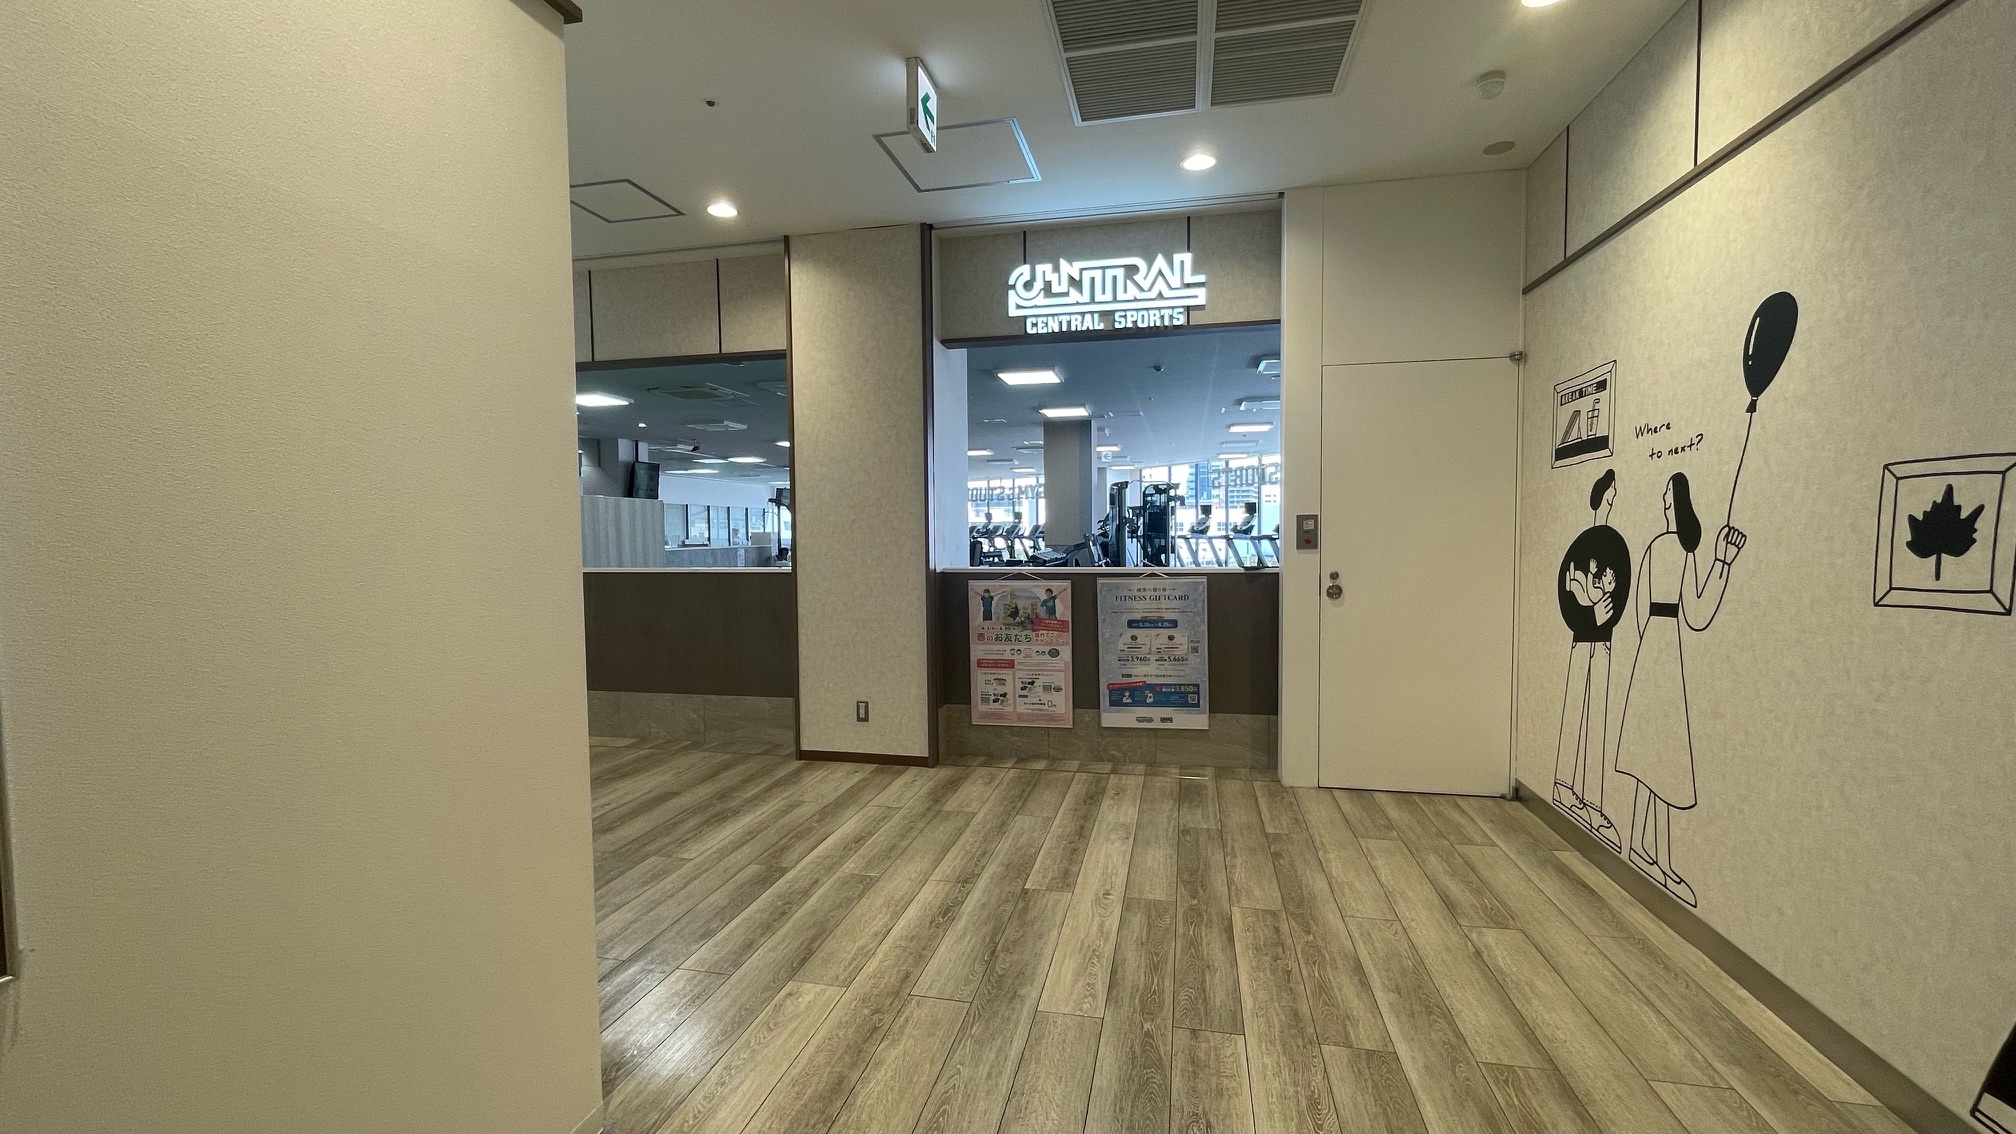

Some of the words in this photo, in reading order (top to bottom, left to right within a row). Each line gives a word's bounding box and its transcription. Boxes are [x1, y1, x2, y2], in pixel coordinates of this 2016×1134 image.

[1008, 252, 1206, 317] CENTRAL
[1026, 312, 1104, 335] CENTRAL
[1114, 308, 1184, 329] SPORTS
[1561, 390, 1580, 405] BREAK
[1634, 422, 1671, 439] Where
[1649, 448, 1662, 460] to
[1668, 433, 1704, 455] next?
[1115, 594, 1147, 602] FITNESS
